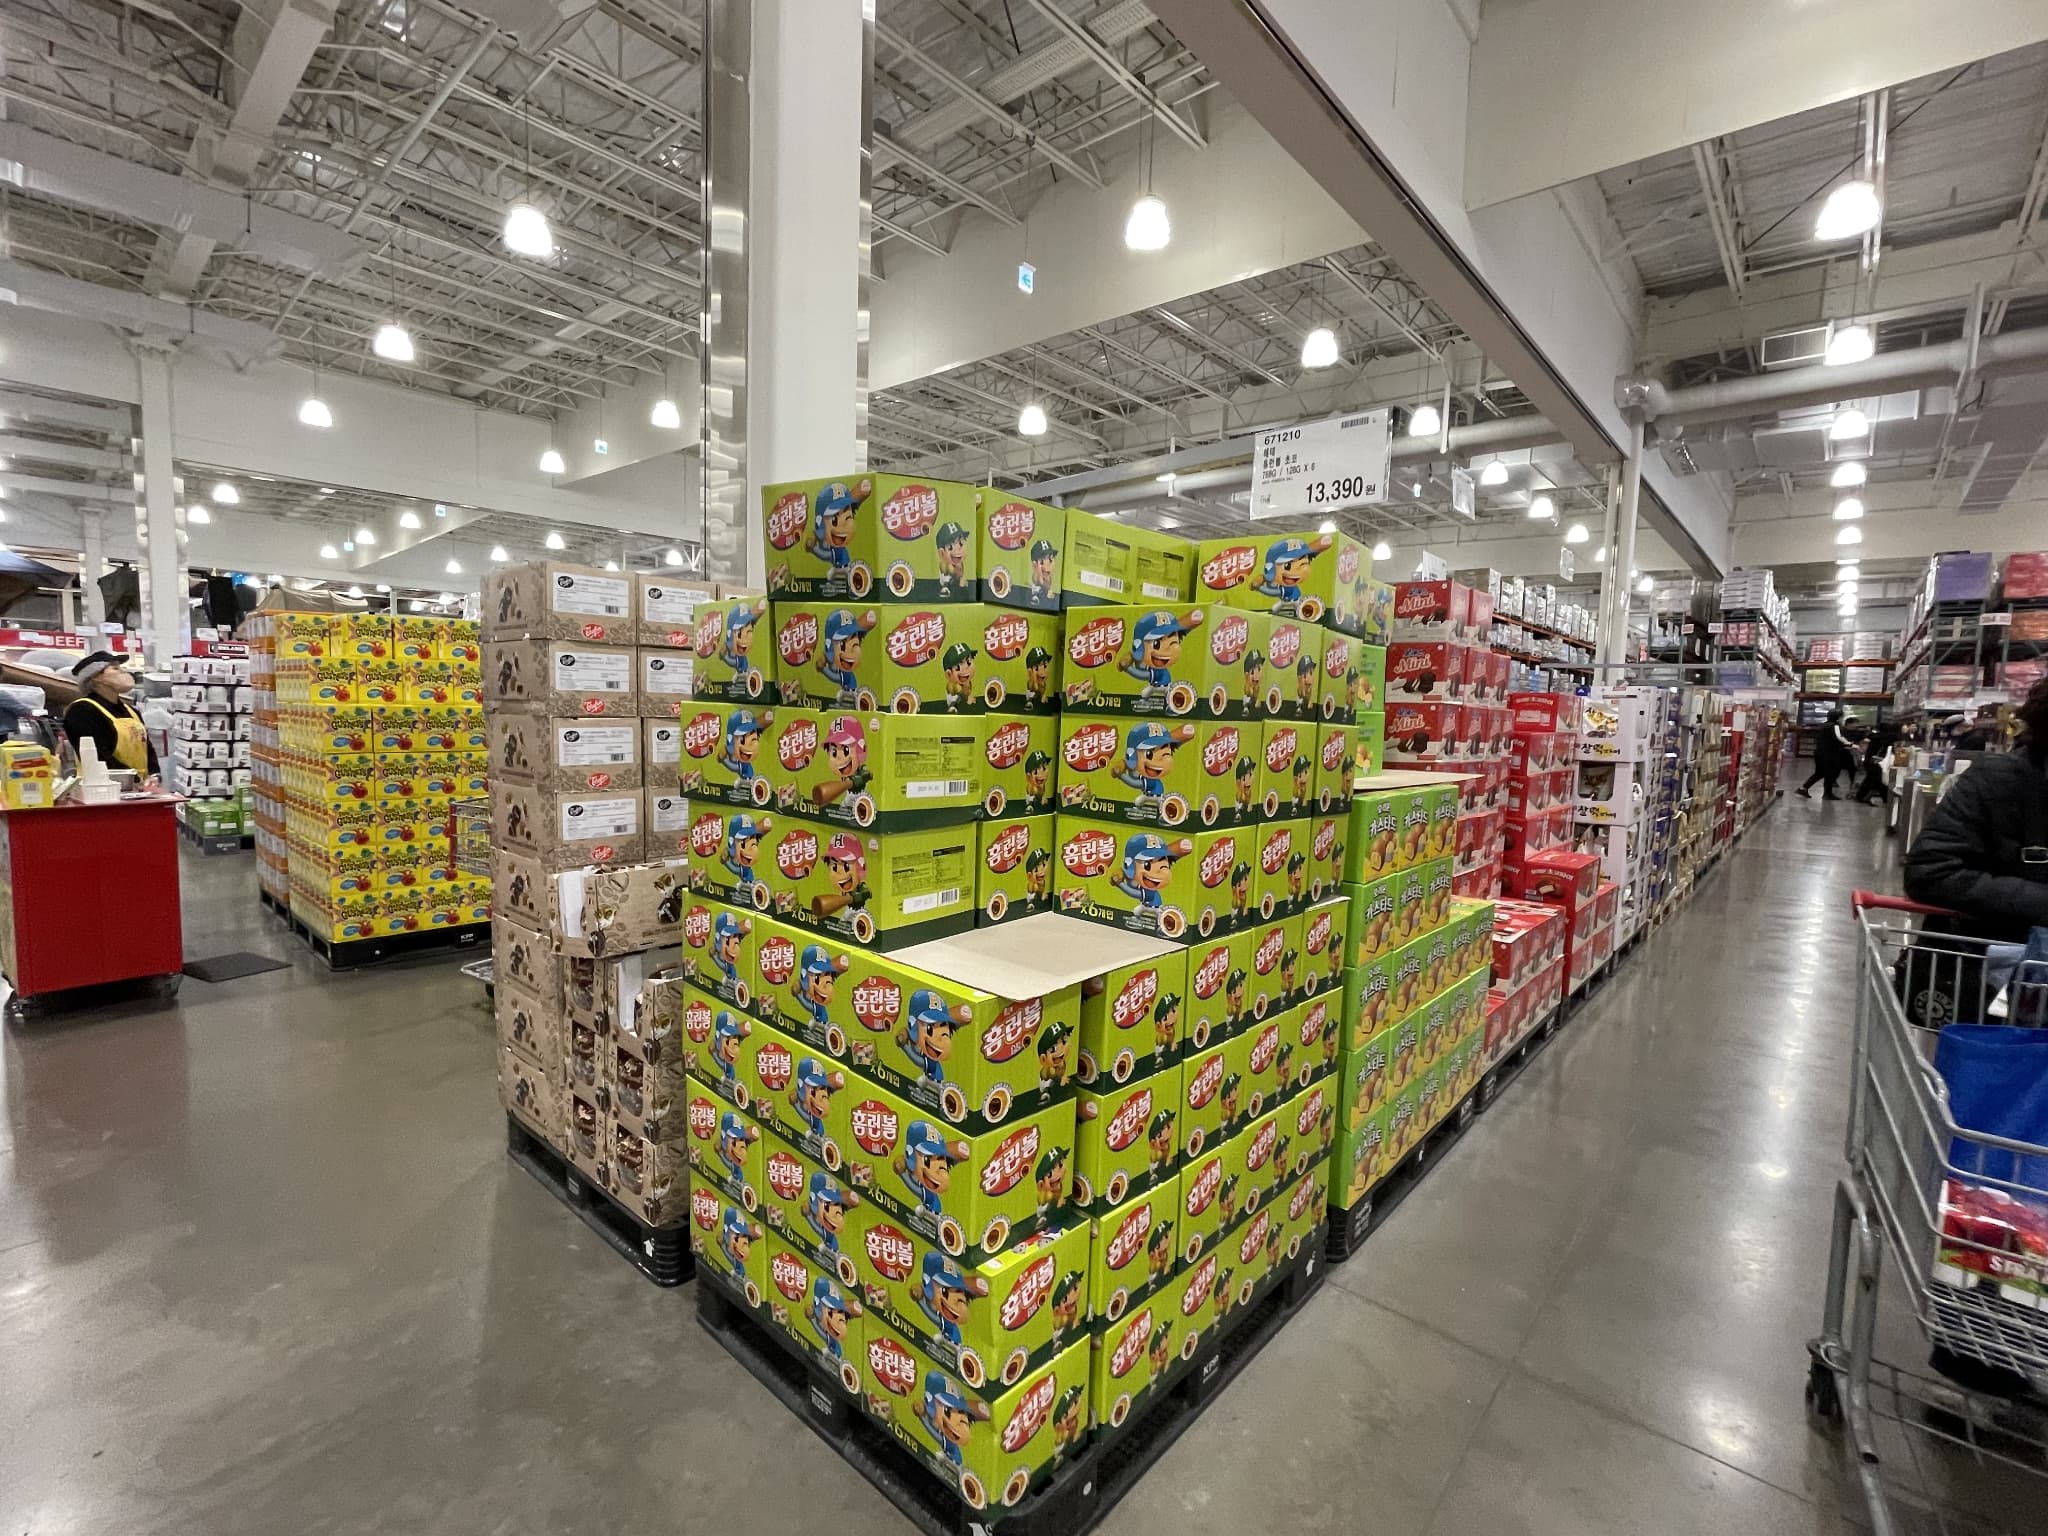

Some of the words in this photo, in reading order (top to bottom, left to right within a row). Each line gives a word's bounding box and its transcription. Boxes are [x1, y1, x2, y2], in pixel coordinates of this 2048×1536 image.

[1264, 430, 1301, 446] 671210
[1306, 476, 1363, 504] 13,390
[768, 495, 809, 539] 홈런볼
[882, 494, 939, 532] 홈런볼
[989, 509, 1036, 541] 홈런볼
[1202, 549, 1257, 579] 홈런볼
[779, 620, 818, 655] 홈런볼
[888, 616, 946, 655] 홈런볼
[985, 622, 1028, 651] 홈런볼
[1070, 622, 1125, 657] 홈런볼
[1211, 623, 1249, 656] 홈런볼
[684, 717, 721, 749] 홈런볼
[778, 727, 818, 760] 홈런볼
[986, 728, 1029, 758] 홈런볼
[1064, 729, 1118, 762] 홈런볼
[1203, 734, 1240, 765] 홈런볼
[1266, 732, 1297, 762] 홈런볼
[691, 819, 723, 848] 홈런볼
[986, 828, 1029, 865] 홈런볼
[778, 837, 818, 870] 홈런볼
[1062, 836, 1117, 868] 홈런볼
[1200, 844, 1235, 881] 홈런볼
[1261, 836, 1292, 868] 홈런볼
[759, 948, 796, 974] 홈런볼
[1194, 949, 1229, 994] 홈런볼
[853, 986, 901, 1015] 홈런볼
[1113, 971, 1158, 1022] 홈런볼
[982, 1001, 1044, 1059] 홈런볼
[757, 1055, 792, 1078] 홈런볼
[1189, 1057, 1224, 1105] 홈런볼
[852, 1110, 898, 1137] 홈런볼
[1106, 1091, 1151, 1146] 홈런볼
[768, 1159, 804, 1186] 홈런볼
[982, 1129, 1040, 1188] 홈런볼
[865, 1232, 914, 1266] 홈런볼
[1107, 1207, 1151, 1262] 홈런볼
[771, 1262, 807, 1289] 홈런볼
[1002, 1258, 1056, 1323] 홈런볼
[868, 1347, 915, 1382] 홈런볼
[1002, 1375, 1056, 1447] 홈런볼
